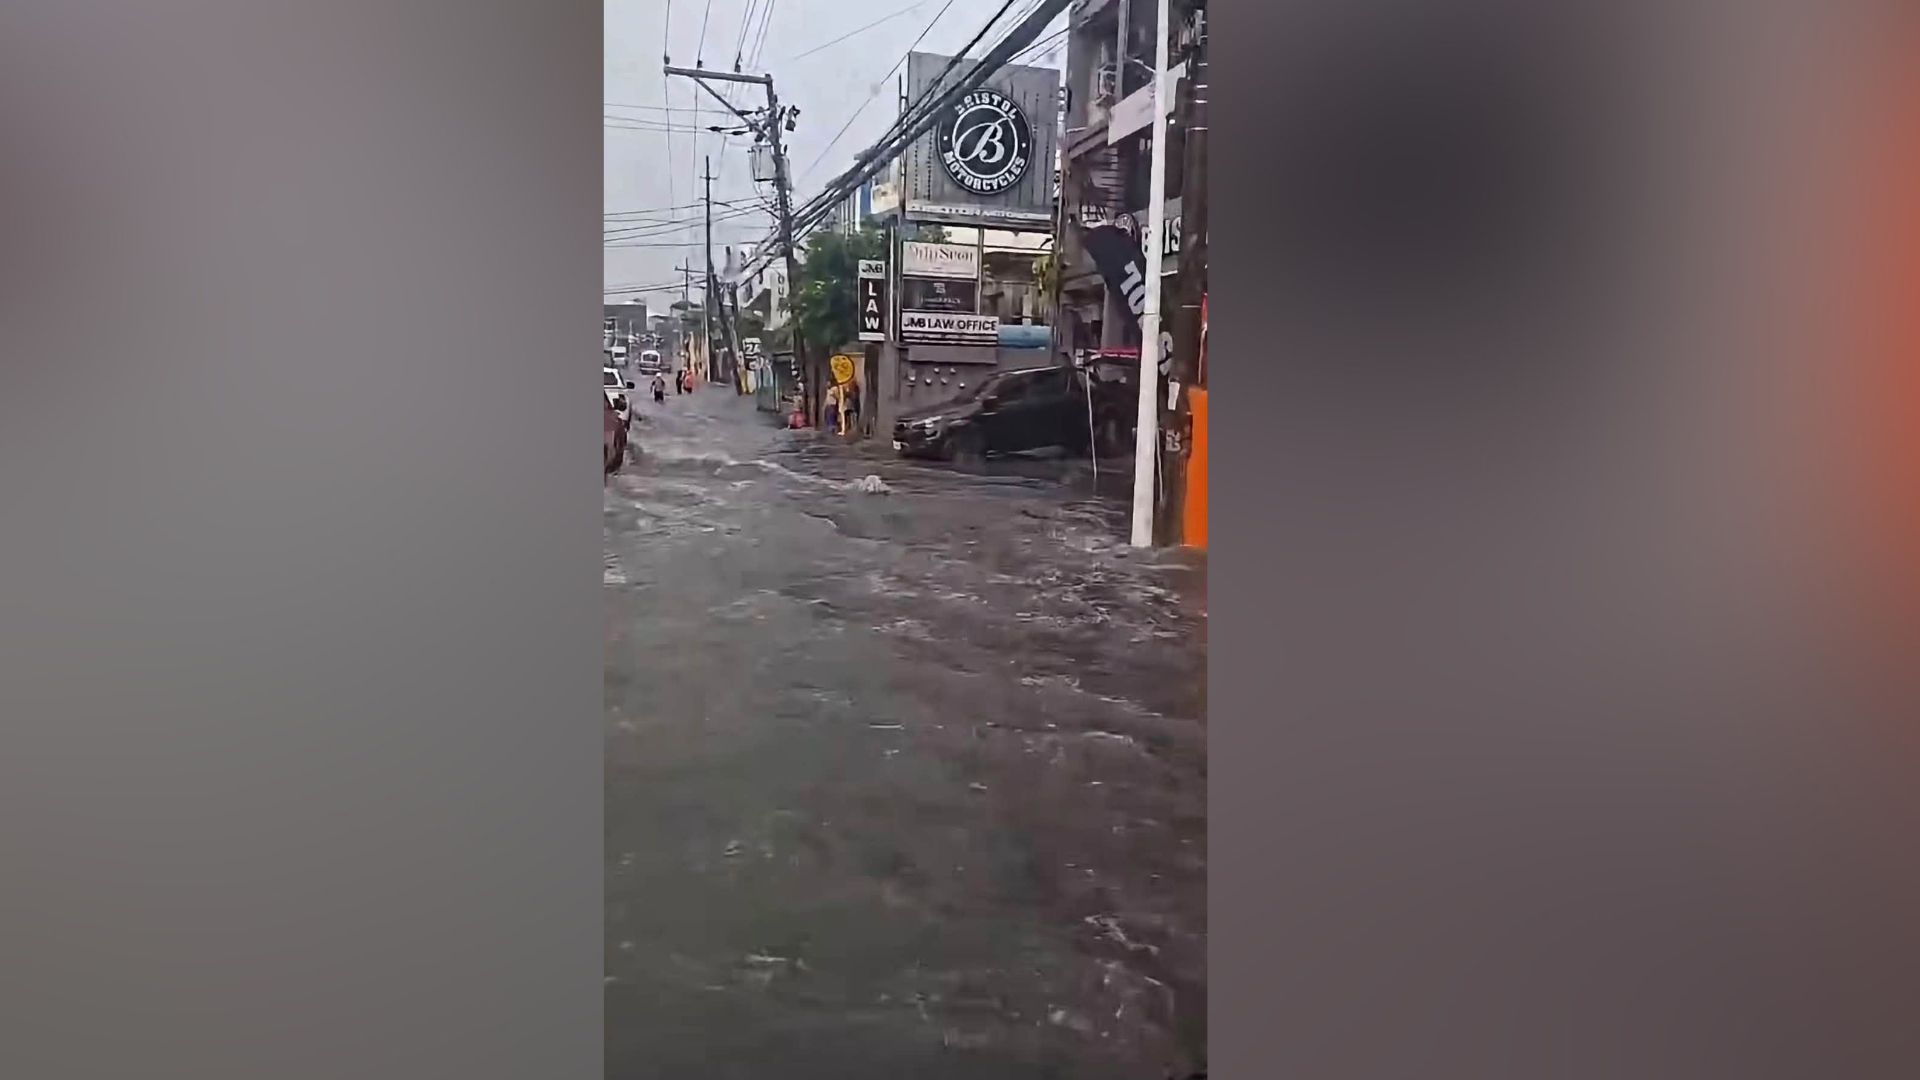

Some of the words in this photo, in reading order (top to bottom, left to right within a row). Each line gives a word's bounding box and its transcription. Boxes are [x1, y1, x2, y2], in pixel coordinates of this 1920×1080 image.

[943, 150, 1025, 191] MOTORCYCLES
[865, 281, 880, 330] LAW
[903, 317, 926, 328] JMB
[928, 317, 954, 329] LAW
[957, 319, 997, 331] OFFICE
